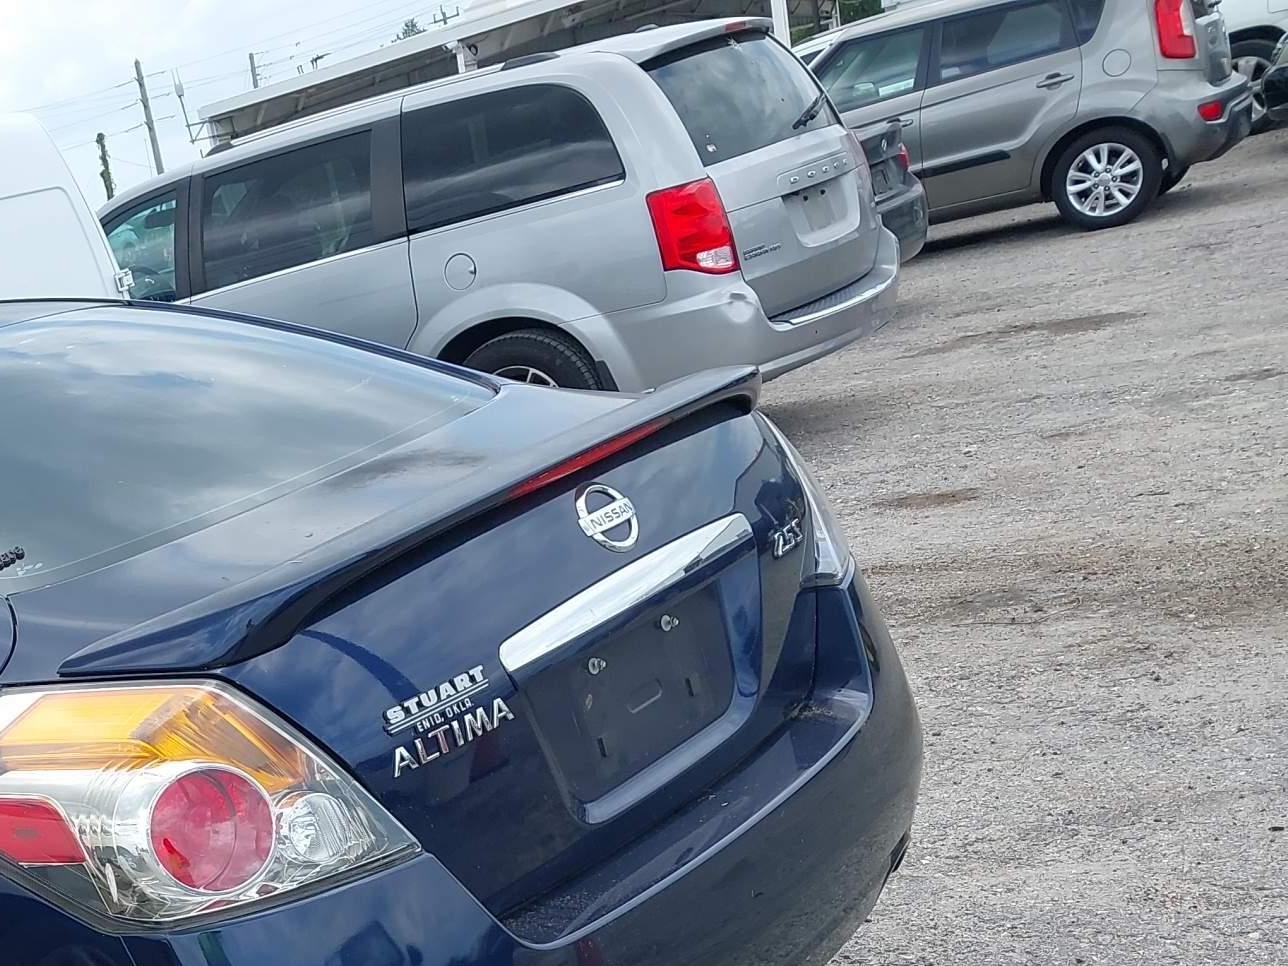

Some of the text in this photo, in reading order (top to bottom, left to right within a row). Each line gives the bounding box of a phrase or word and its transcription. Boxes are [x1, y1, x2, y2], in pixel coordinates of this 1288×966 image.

[590, 502, 632, 530] NISSAN
[385, 664, 484, 724] STUART
[416, 698, 475, 732] ENID, OKLA.
[393, 697, 515, 778] ALTIMA
